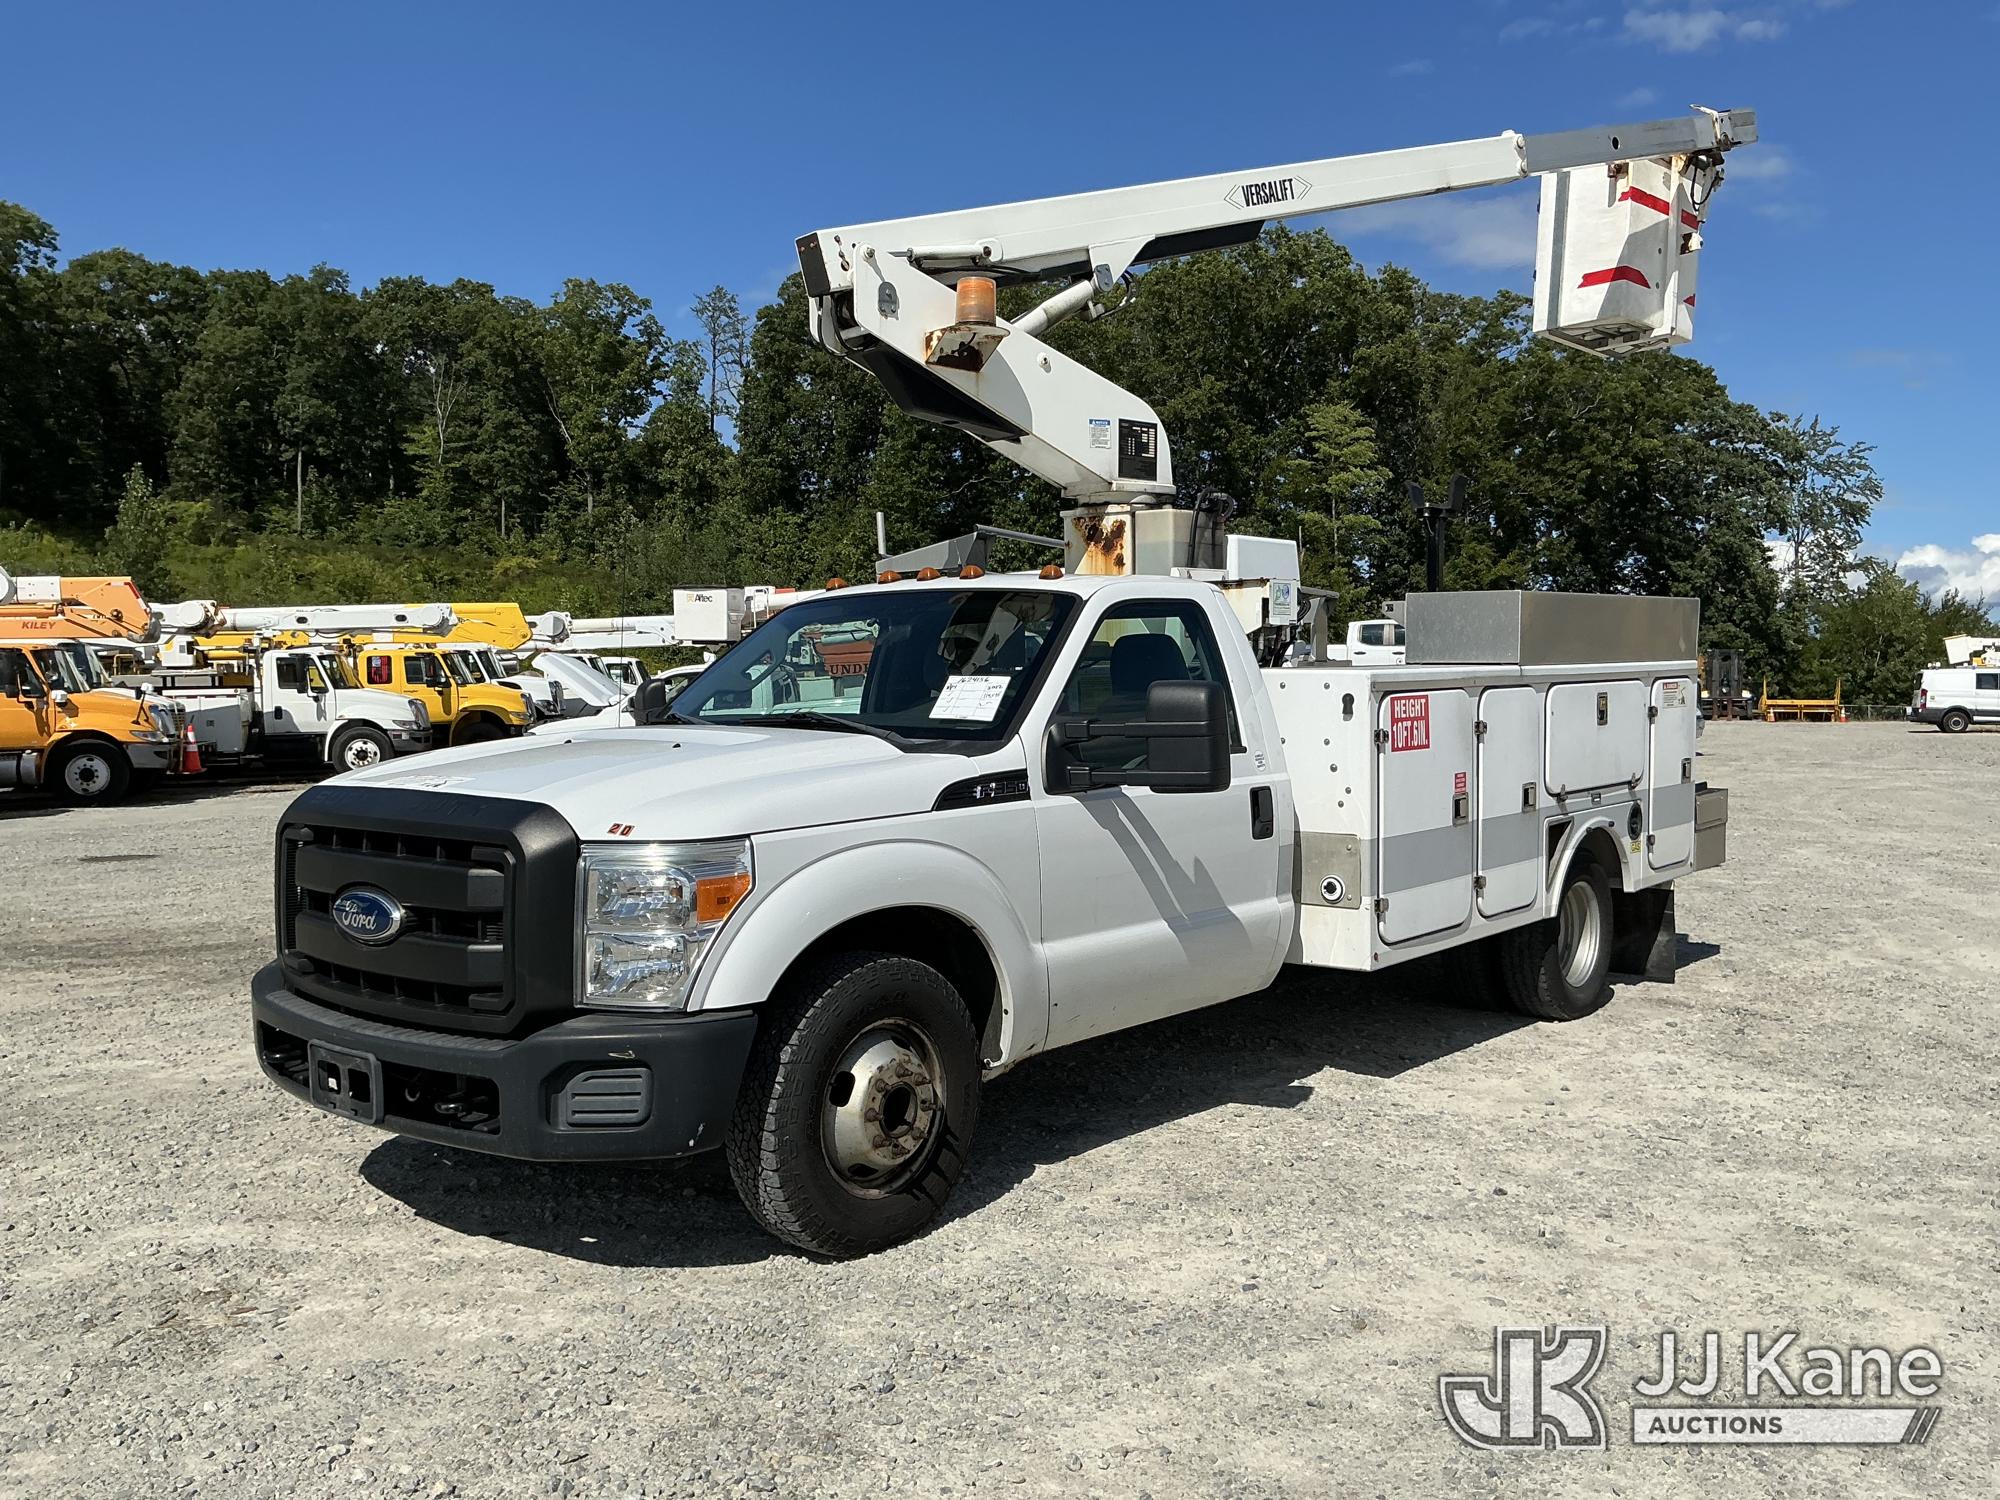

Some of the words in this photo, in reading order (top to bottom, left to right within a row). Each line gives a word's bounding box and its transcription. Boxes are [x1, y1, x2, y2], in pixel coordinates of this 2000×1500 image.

[1241, 178, 1295, 207] VERSALIFT
[694, 593, 713, 603] Altec
[21, 621, 56, 630] KILEY
[1394, 698, 1426, 719] HEIGHT
[607, 823, 635, 837] 20
[342, 899, 378, 930] Ford
